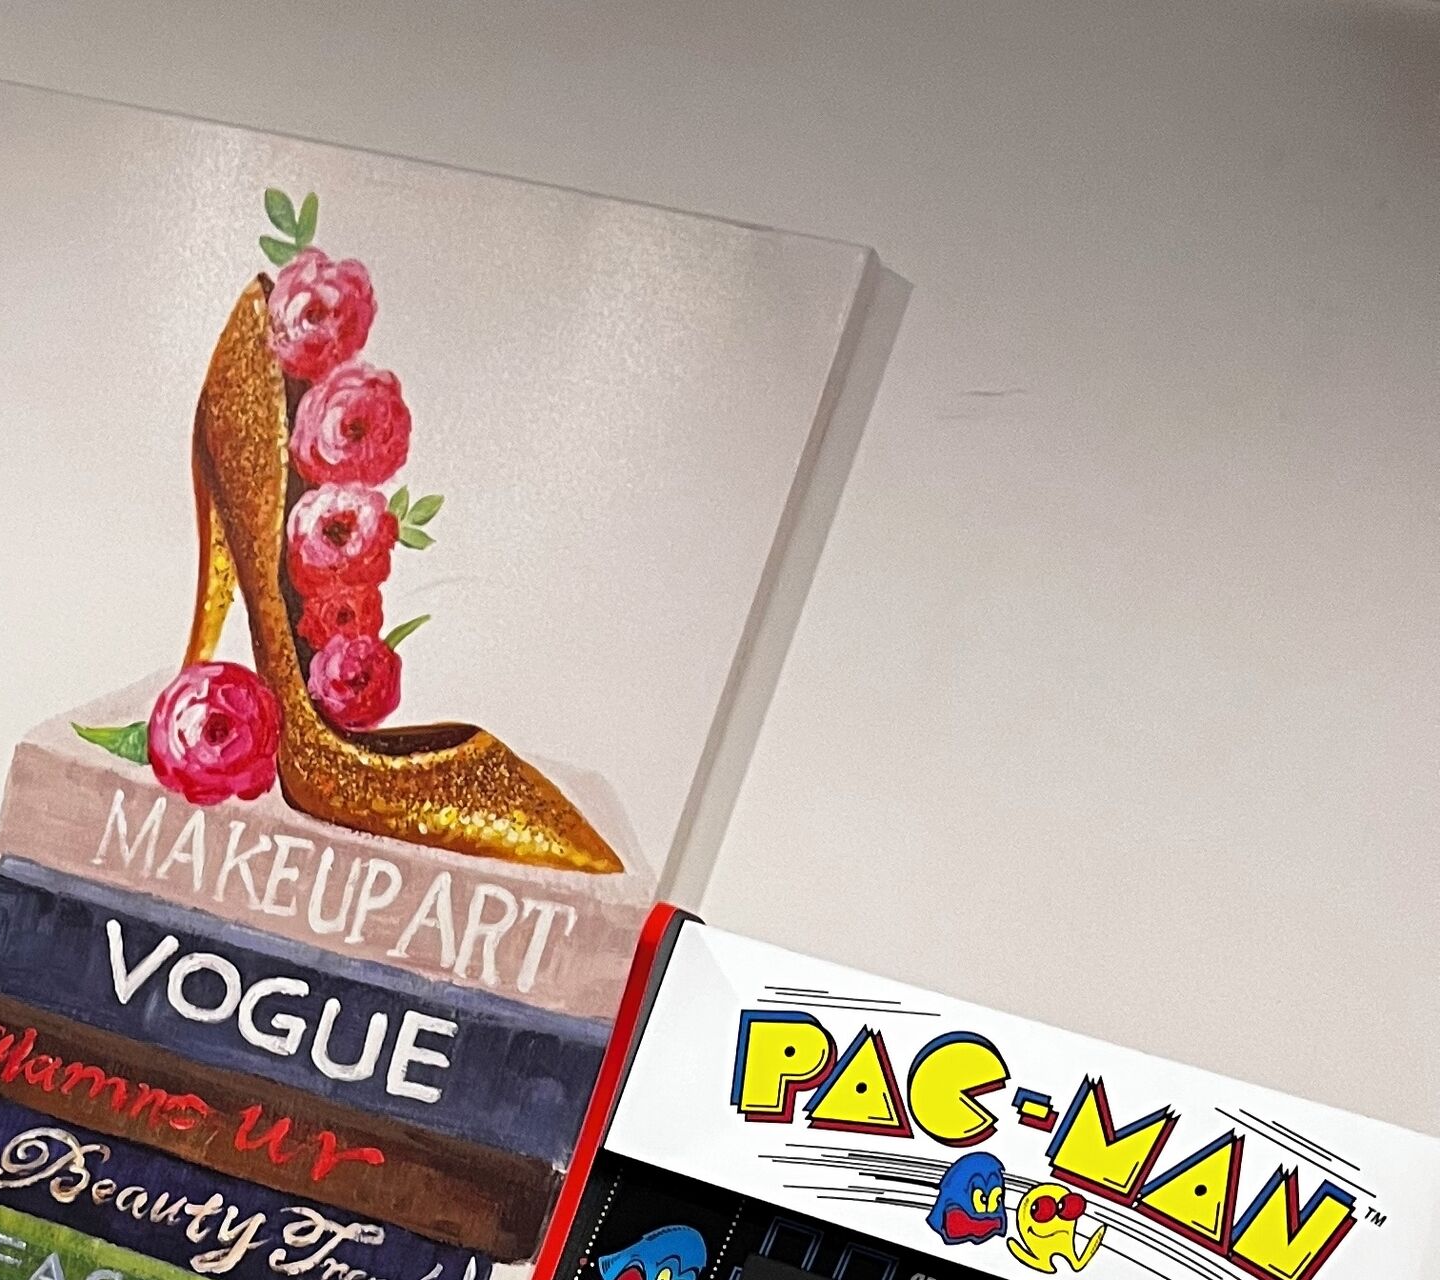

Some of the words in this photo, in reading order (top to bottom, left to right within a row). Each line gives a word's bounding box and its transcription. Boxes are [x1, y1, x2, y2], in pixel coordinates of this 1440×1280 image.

[92, 788, 405, 945] MAKEUP
[386, 871, 578, 994] ART
[106, 919, 459, 1104] VOGUE
